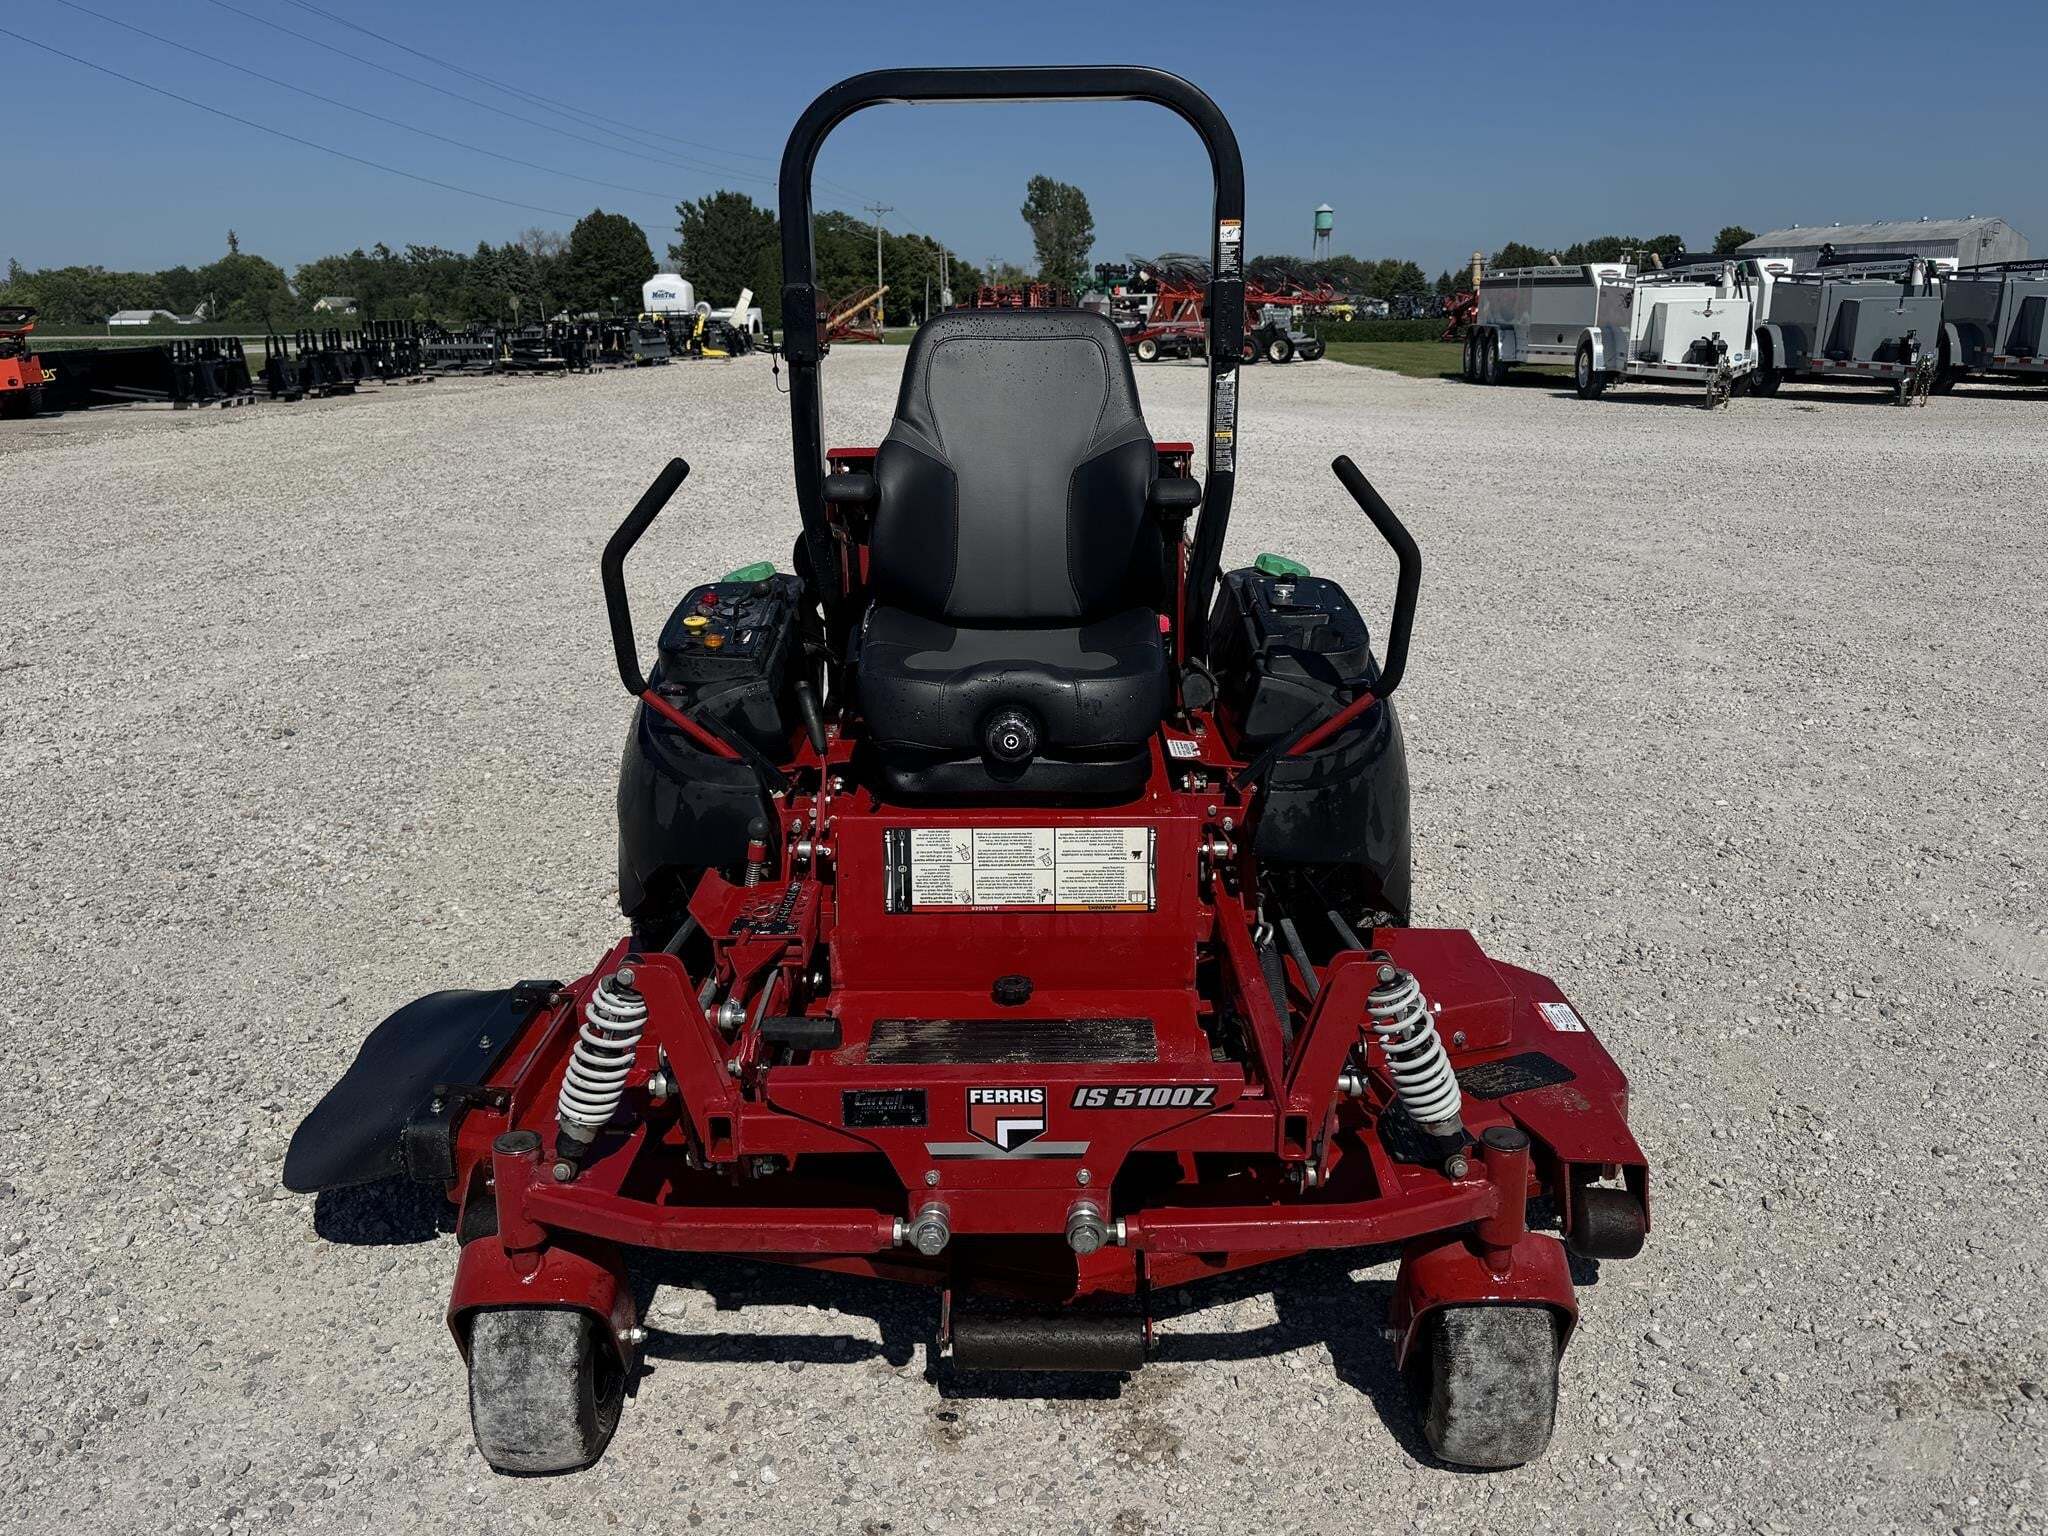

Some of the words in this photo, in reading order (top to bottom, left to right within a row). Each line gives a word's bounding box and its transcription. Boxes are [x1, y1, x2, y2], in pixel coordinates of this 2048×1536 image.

[970, 1089, 1044, 1103] FERRIS
[1073, 1088, 1109, 1107] IS
[1114, 1087, 1216, 1107] 5100Z
